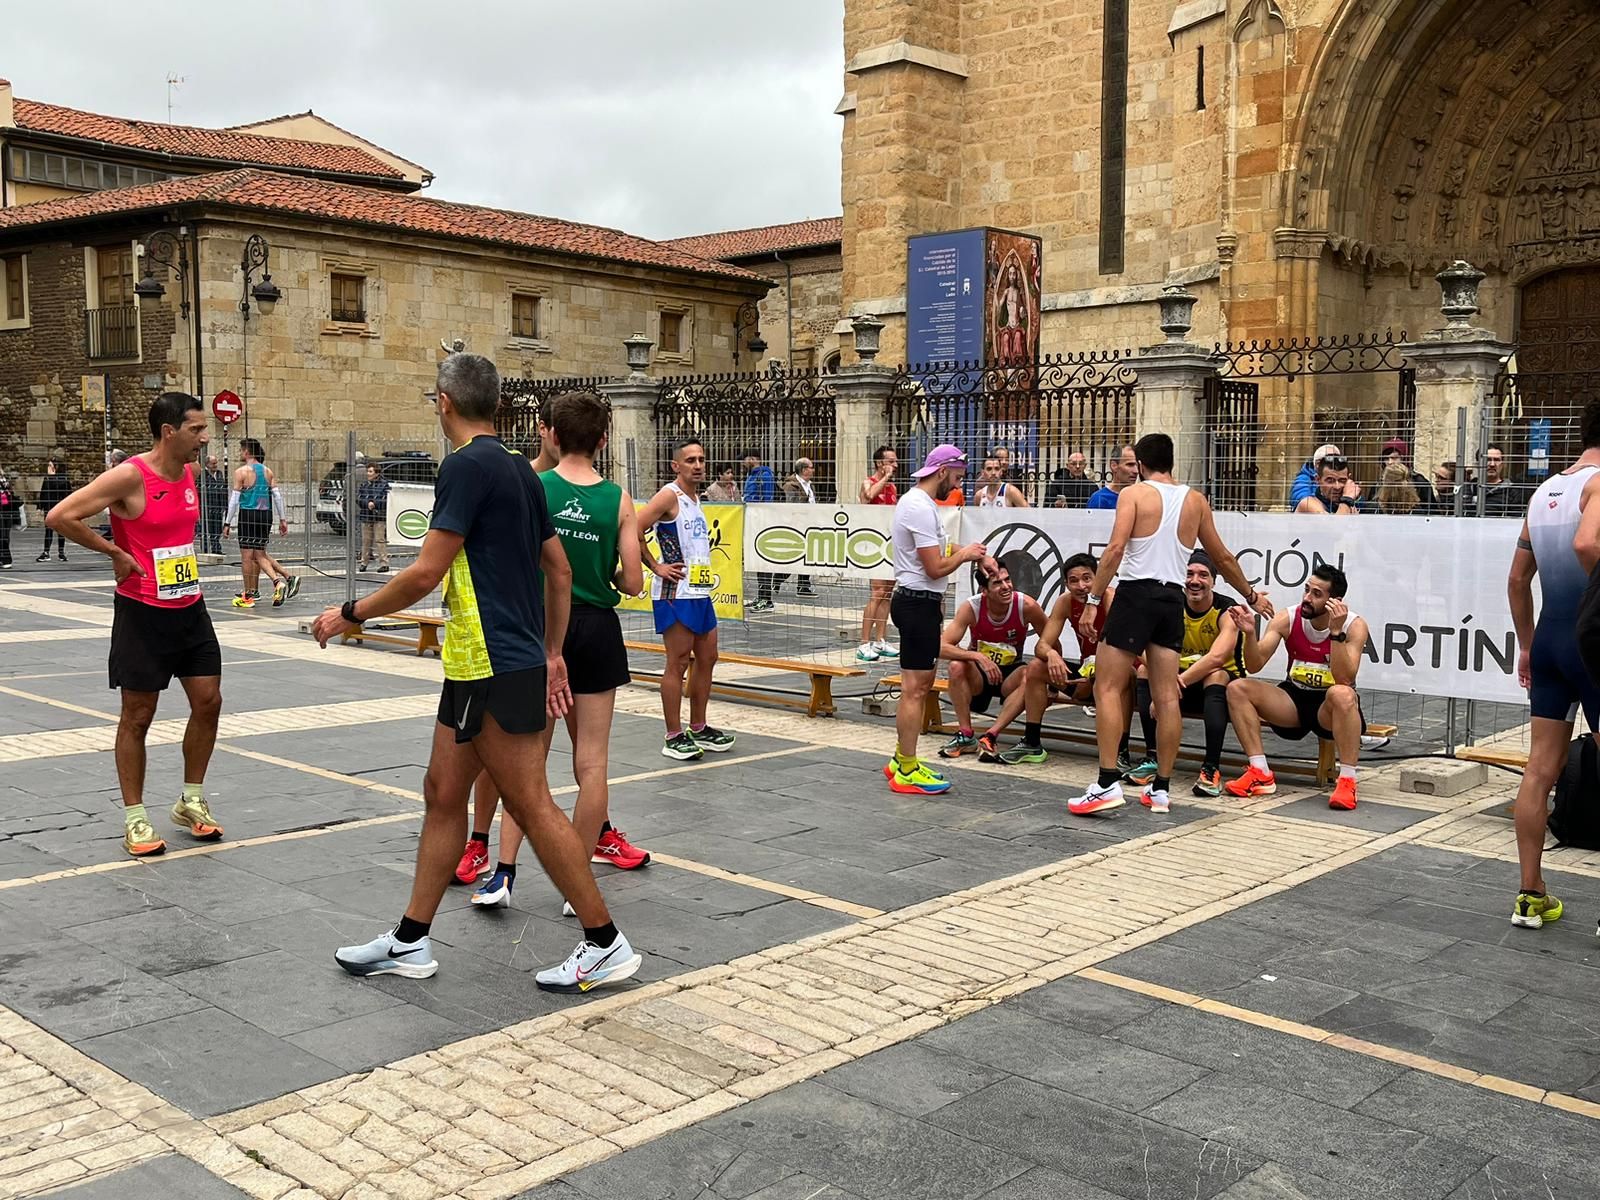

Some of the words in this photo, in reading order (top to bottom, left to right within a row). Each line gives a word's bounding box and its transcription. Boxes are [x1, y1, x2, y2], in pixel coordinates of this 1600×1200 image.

[573, 531, 599, 542] LEÓN
[755, 512, 894, 569] emic
[175, 562, 191, 582] 84
[699, 570, 710, 583] 55
[1362, 614, 1515, 674] RTÍN
[989, 650, 1003, 664] 36
[1306, 673, 1322, 686] 39
